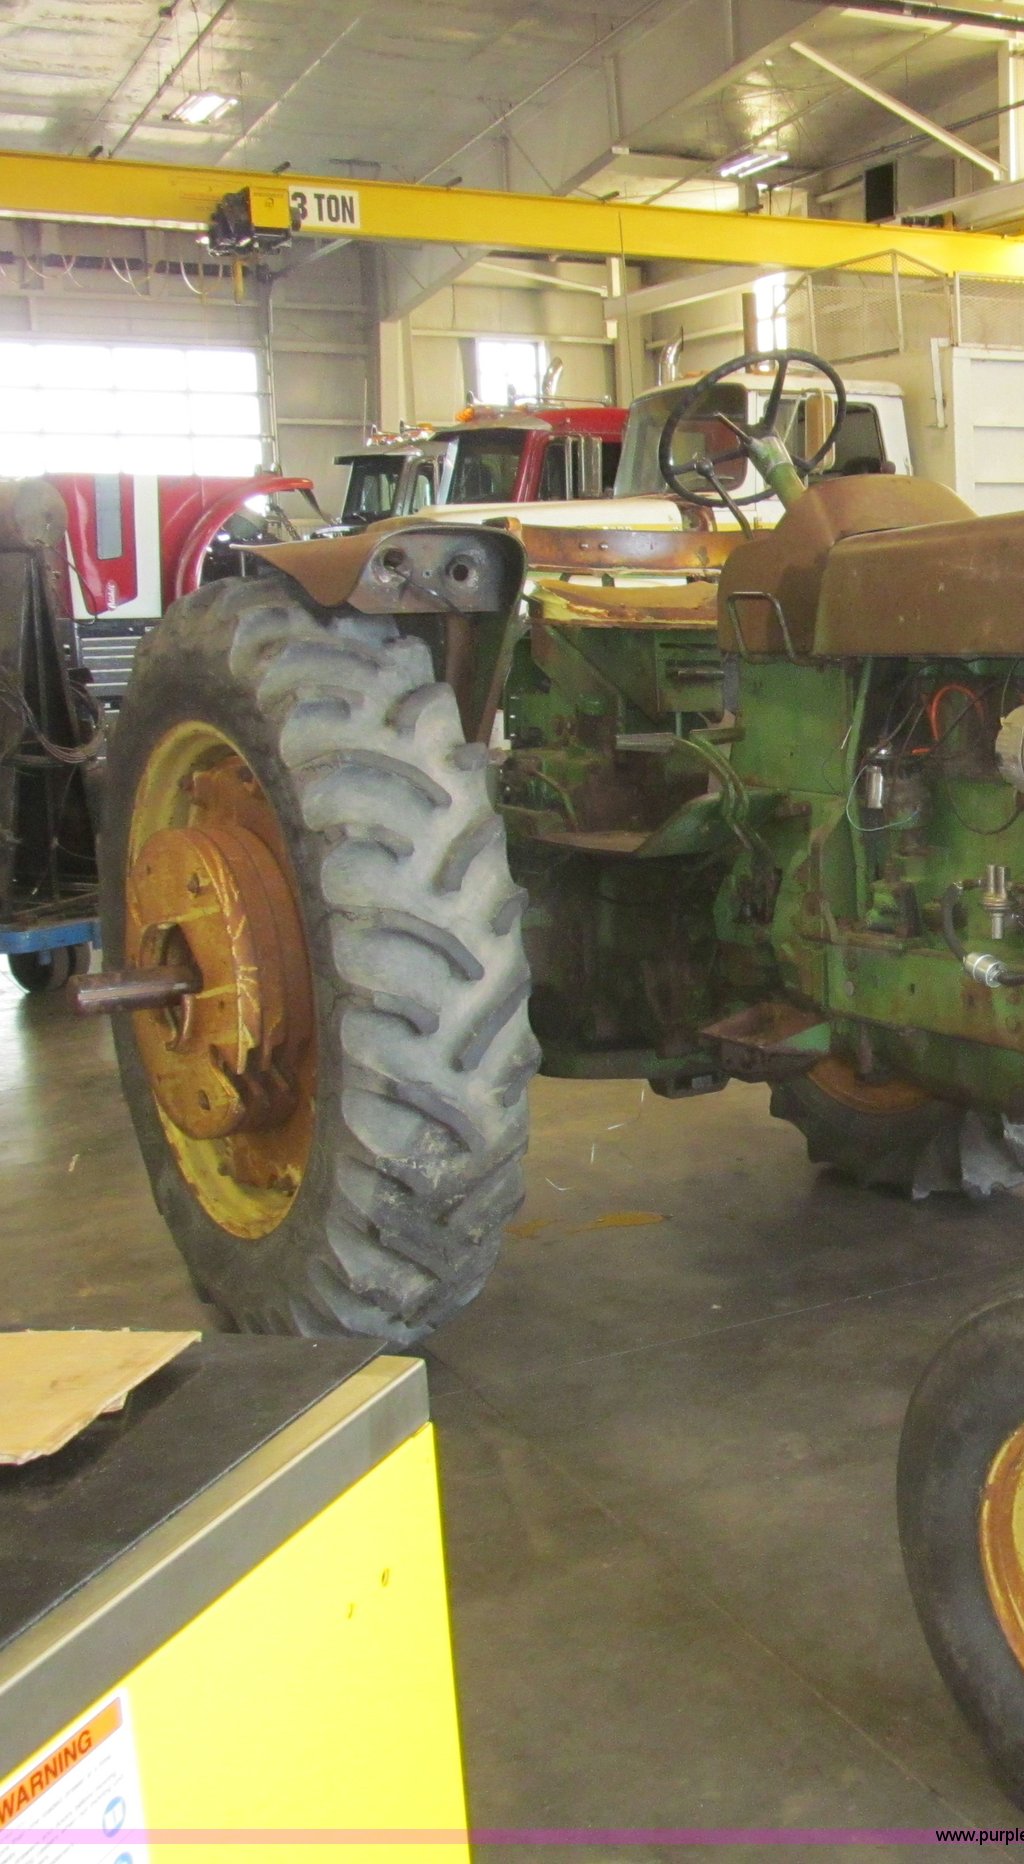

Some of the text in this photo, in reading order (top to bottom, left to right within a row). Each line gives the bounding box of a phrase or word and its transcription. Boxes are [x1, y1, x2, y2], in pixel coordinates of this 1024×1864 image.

[291, 191, 355, 225] 3 TON
[0, 1729, 93, 1825] WARNING
